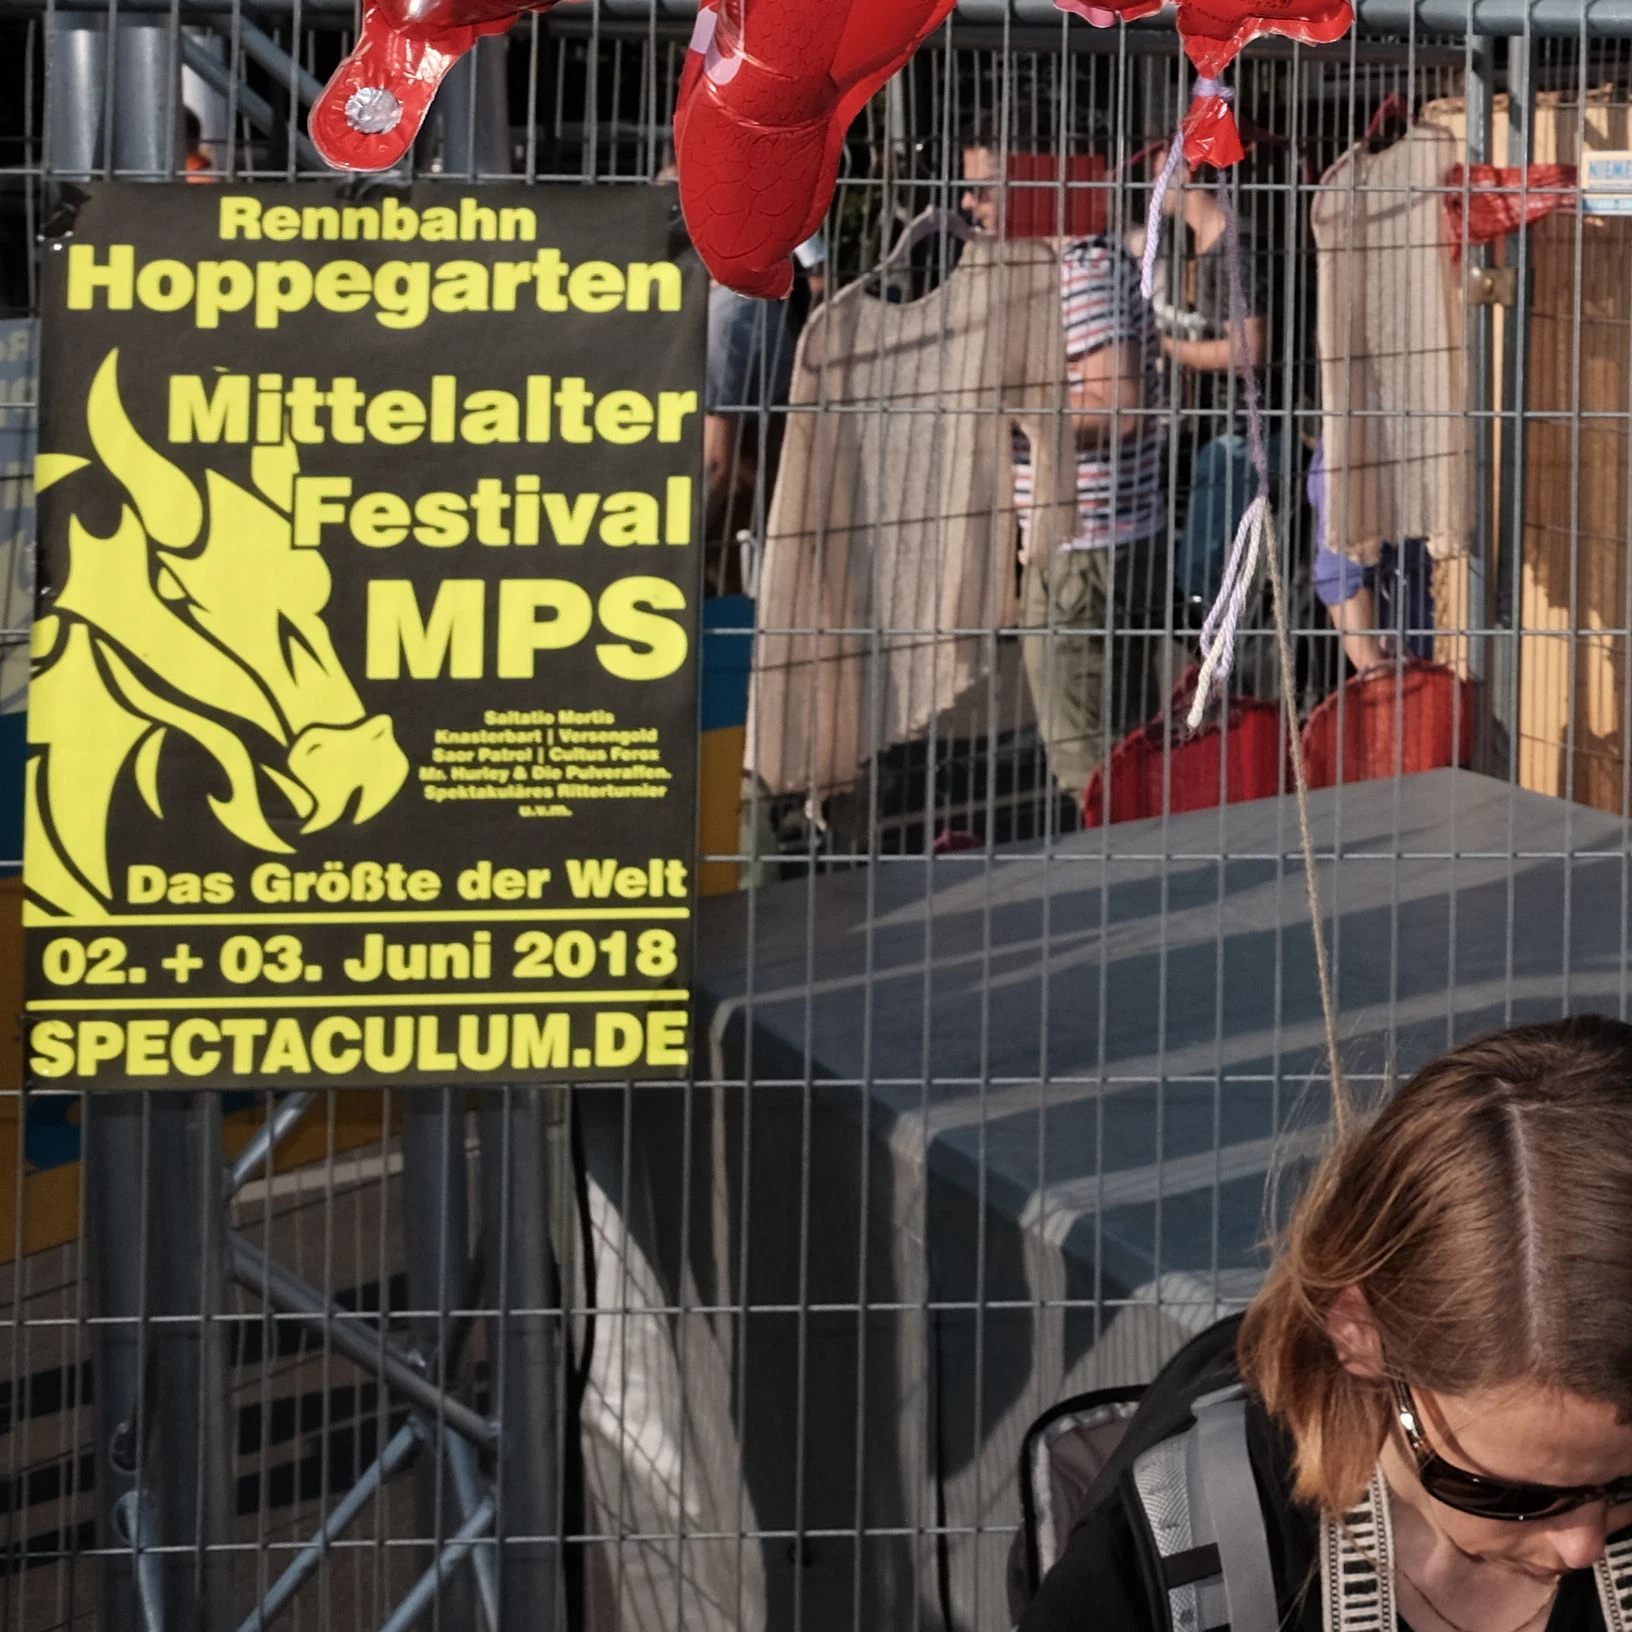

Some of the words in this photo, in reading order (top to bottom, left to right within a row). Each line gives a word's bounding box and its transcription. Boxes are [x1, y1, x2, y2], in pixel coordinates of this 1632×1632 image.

[219, 196, 537, 242] Rennbahn
[67, 244, 682, 330] Hoppegarten
[168, 373, 697, 446] Mittelalter
[297, 475, 692, 549] Festival
[365, 576, 689, 681] MPS
[558, 709, 615, 725] Mortis
[512, 765, 528, 781] &
[128, 865, 235, 904] Das
[251, 861, 441, 903] Größte
[457, 861, 551, 900] der
[566, 858, 687, 899] Welt
[42, 937, 147, 986] 02.
[162, 944, 203, 983] +
[219, 935, 323, 984] 03.
[344, 930, 491, 982] Juni
[513, 929, 678, 978] 2018
[27, 1009, 688, 1078] SPECTACULUM.DE
